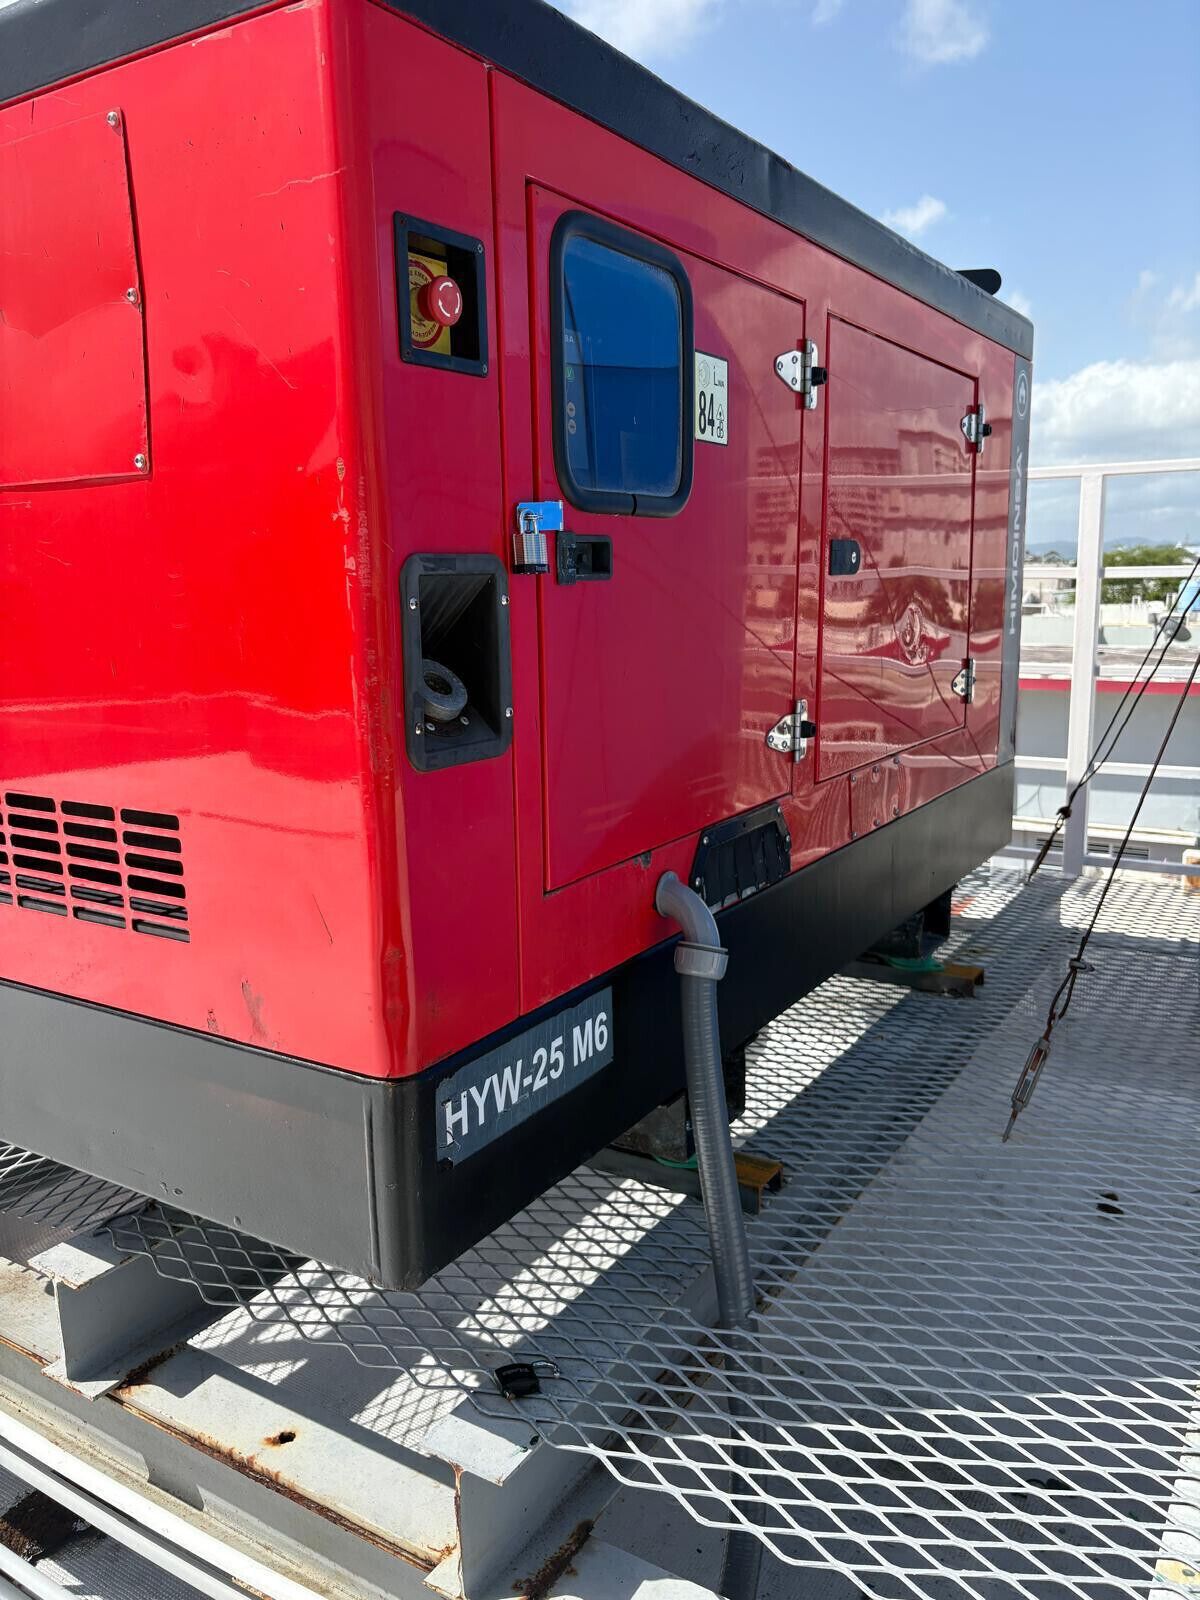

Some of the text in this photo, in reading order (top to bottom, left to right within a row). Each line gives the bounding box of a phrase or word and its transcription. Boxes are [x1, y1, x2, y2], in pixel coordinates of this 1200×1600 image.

[699, 390, 715, 437] 84
[445, 1011, 608, 1146] HYW-25 M6
